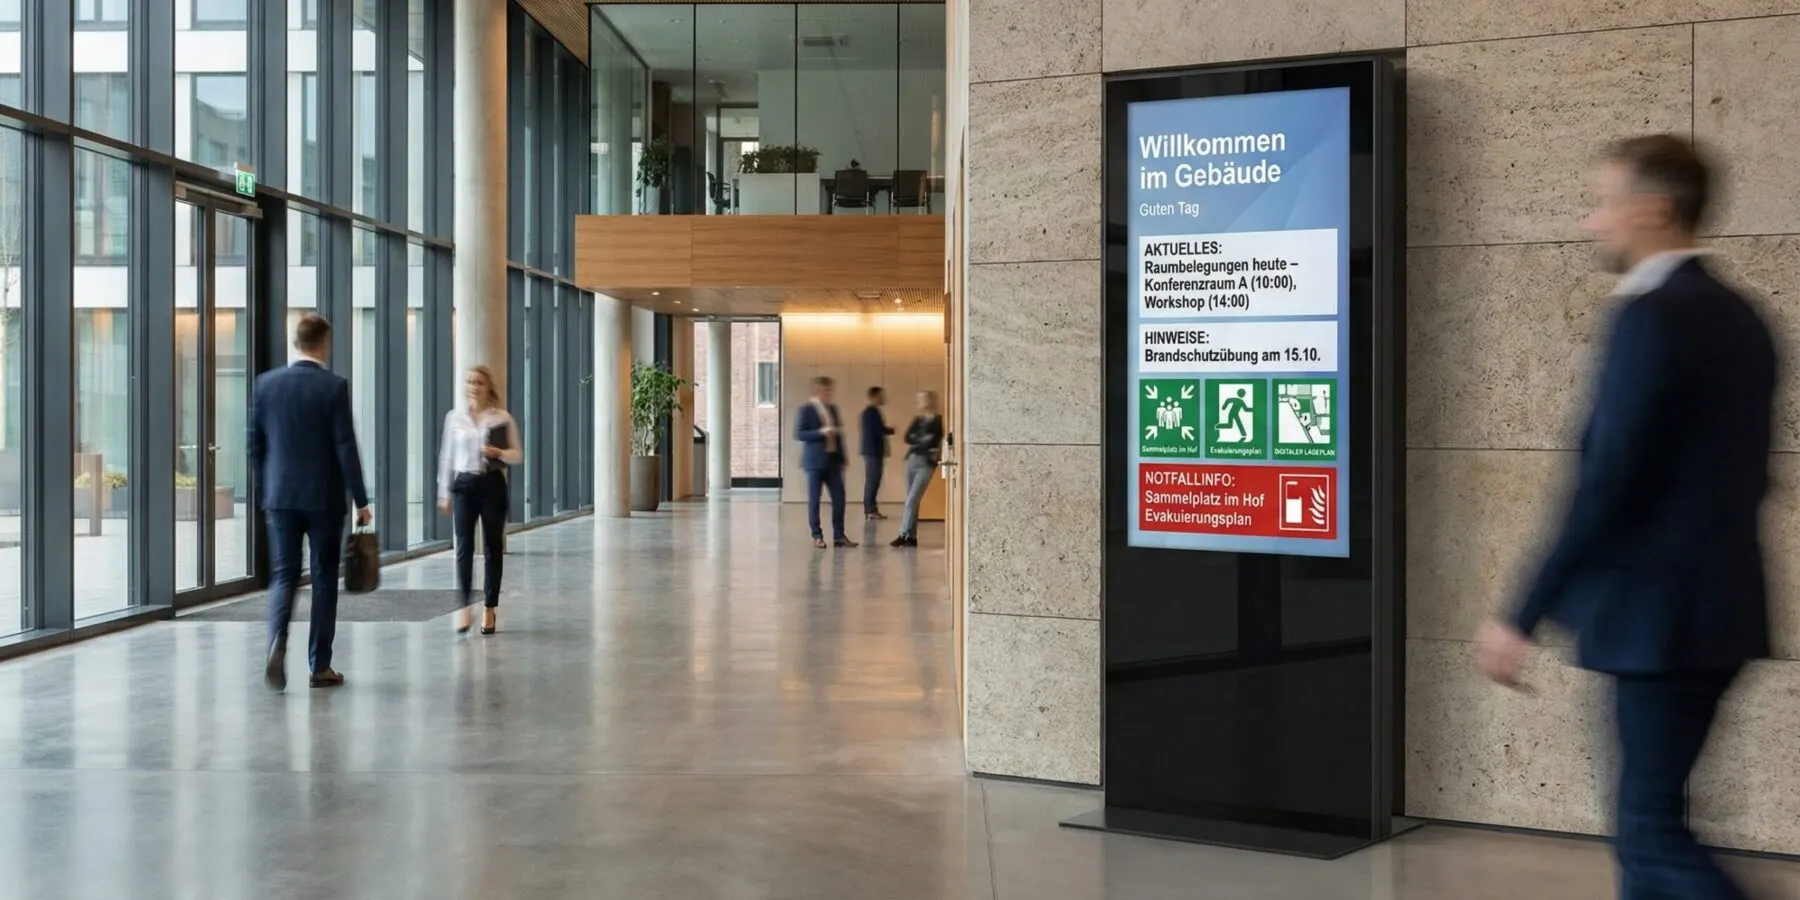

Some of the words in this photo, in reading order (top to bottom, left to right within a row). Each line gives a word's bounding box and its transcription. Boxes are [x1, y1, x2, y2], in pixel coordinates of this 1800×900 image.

[1140, 133, 1285, 158] Willkommen
[1140, 167, 1167, 189] im
[1175, 160, 1281, 187] Gebäude
[1140, 203, 1174, 216] Guten
[1178, 202, 1199, 217] Tag
[1144, 241, 1222, 256] AKTUELLES:
[1145, 258, 1249, 275] Raumbelegungen
[1253, 257, 1287, 271] heute
[1145, 276, 1235, 291] Konferenzraum
[1238, 276, 1248, 289] A
[1250, 274, 1297, 292] (10:00),
[1145, 295, 1205, 311] Workshop
[1208, 293, 1250, 311] (14:00)
[1145, 331, 1209, 344] HINWEISE:
[1145, 348, 1258, 365] Brandschutzübung
[1261, 351, 1280, 361] am
[1285, 347, 1321, 361] 15.10.
[1145, 471, 1235, 487] NOTFALLINFO:
[1145, 490, 1221, 507] Sammelplatz
[1224, 493, 1239, 506] im
[1242, 493, 1265, 507] Hof
[1145, 508, 1252, 527] Evakuierungsplan
